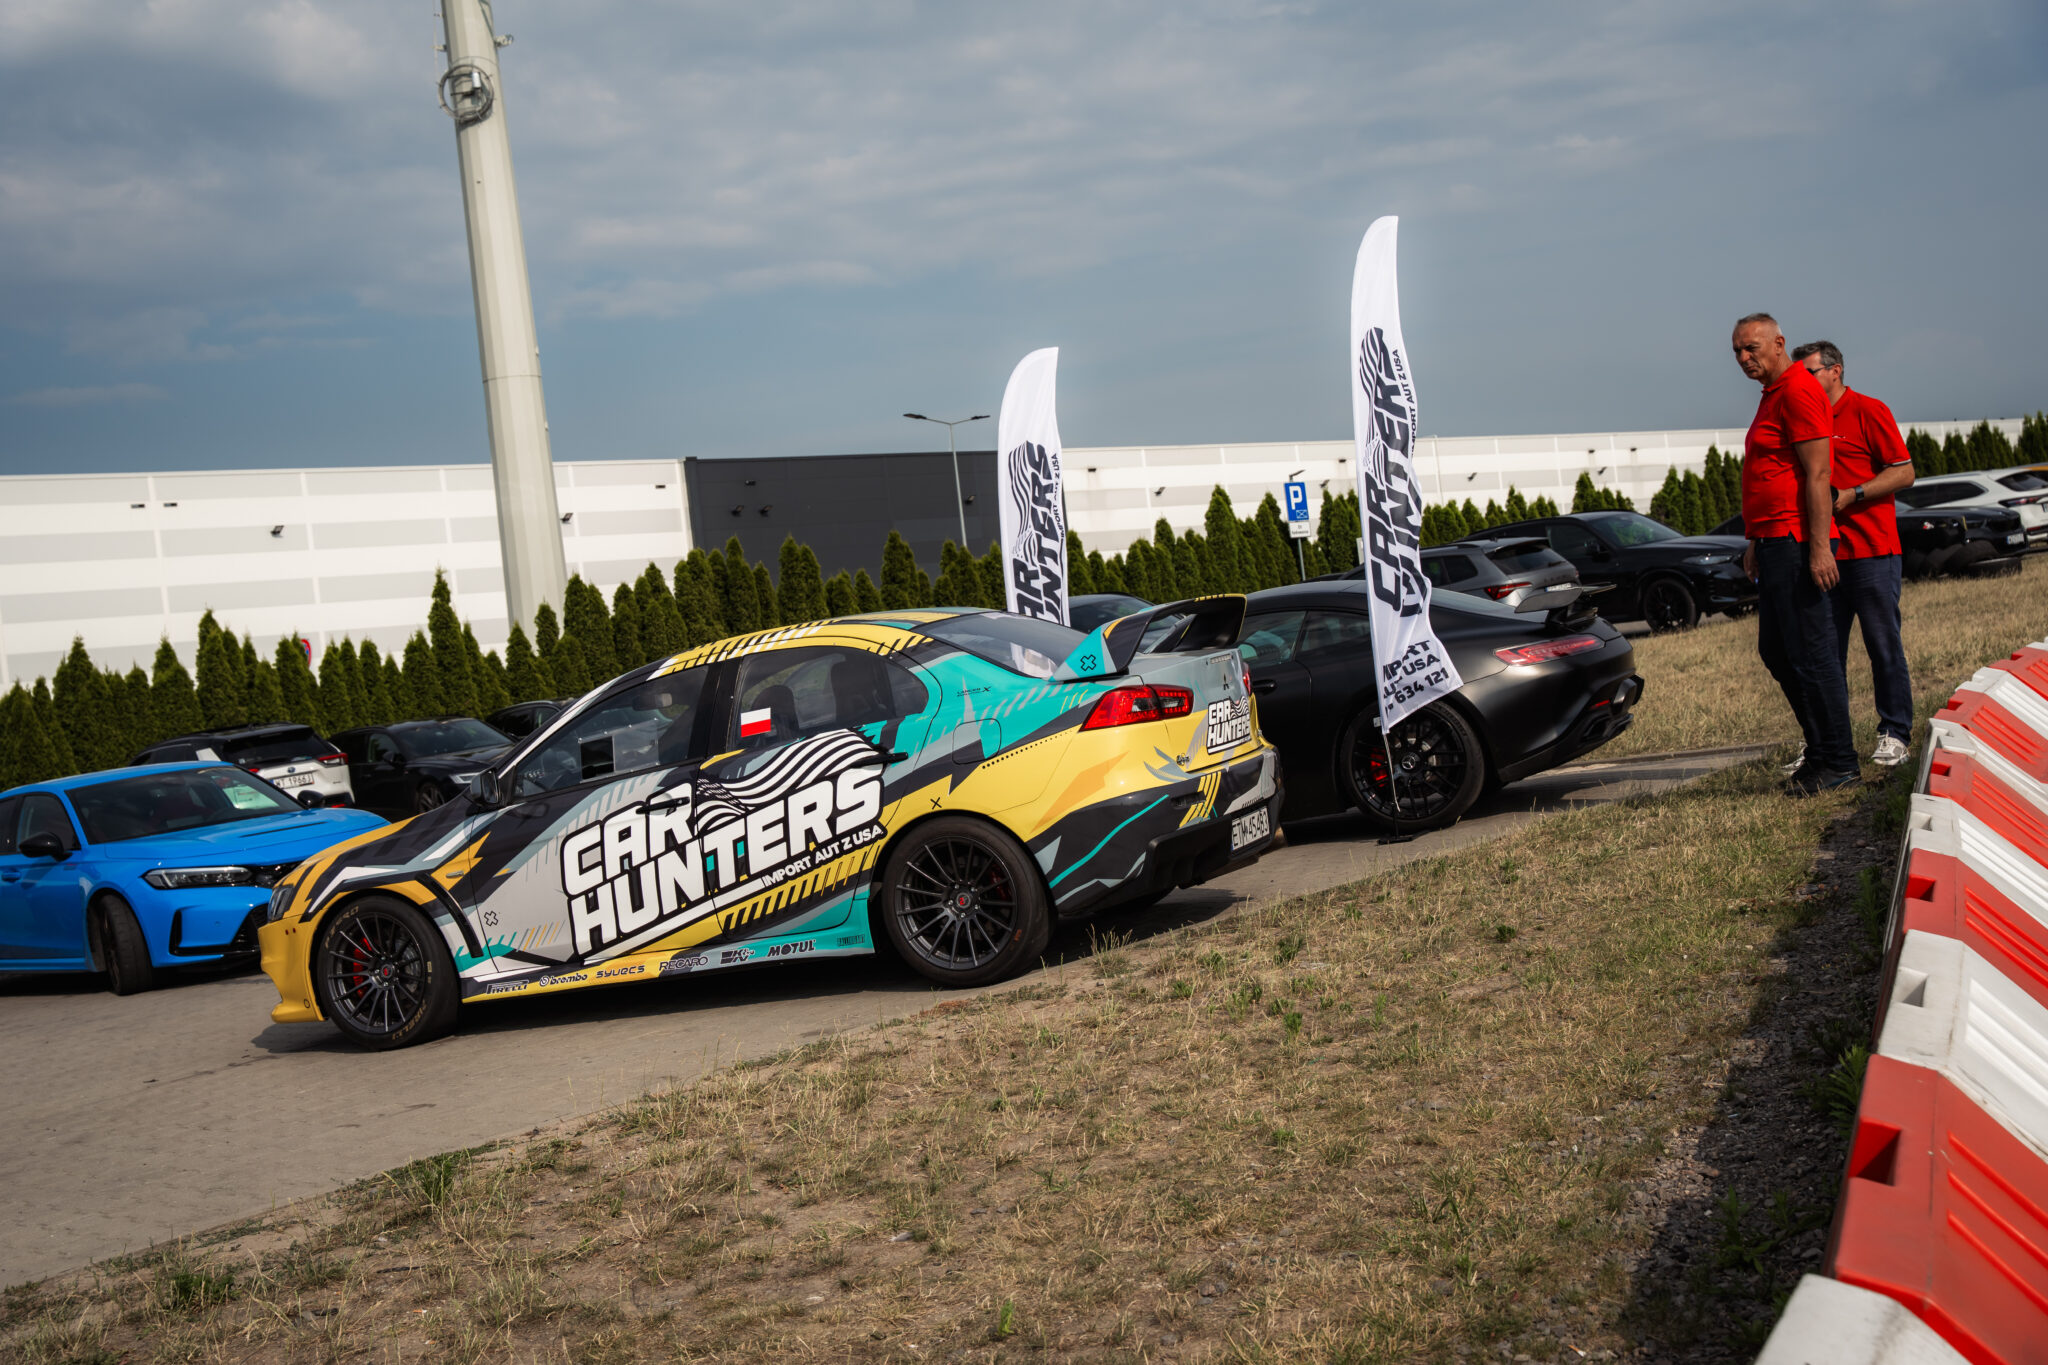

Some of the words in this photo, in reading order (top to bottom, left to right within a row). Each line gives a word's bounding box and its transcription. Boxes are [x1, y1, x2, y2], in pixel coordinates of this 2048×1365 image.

[1392, 349, 1403, 372] USA
[1401, 382, 1415, 404] AUT
[1289, 485, 1303, 510] P
[1365, 471, 1402, 612] CAR
[1012, 557, 1045, 618] AR
[1402, 653, 1440, 676] USA
[1394, 681, 1425, 704] 634
[1424, 667, 1449, 687] 121
[1208, 699, 1231, 726] CAR
[564, 782, 697, 896] CAR
[571, 769, 882, 956] HUNTERS
[761, 855, 812, 887] IMPORT
[815, 841, 841, 864] AUT
[841, 836, 853, 851] Z
[853, 824, 883, 845] USA
[767, 940, 815, 958] MOTUL
[659, 956, 709, 972] RECARO
[486, 979, 529, 995] PIRELLI
[549, 973, 588, 985] brembo
